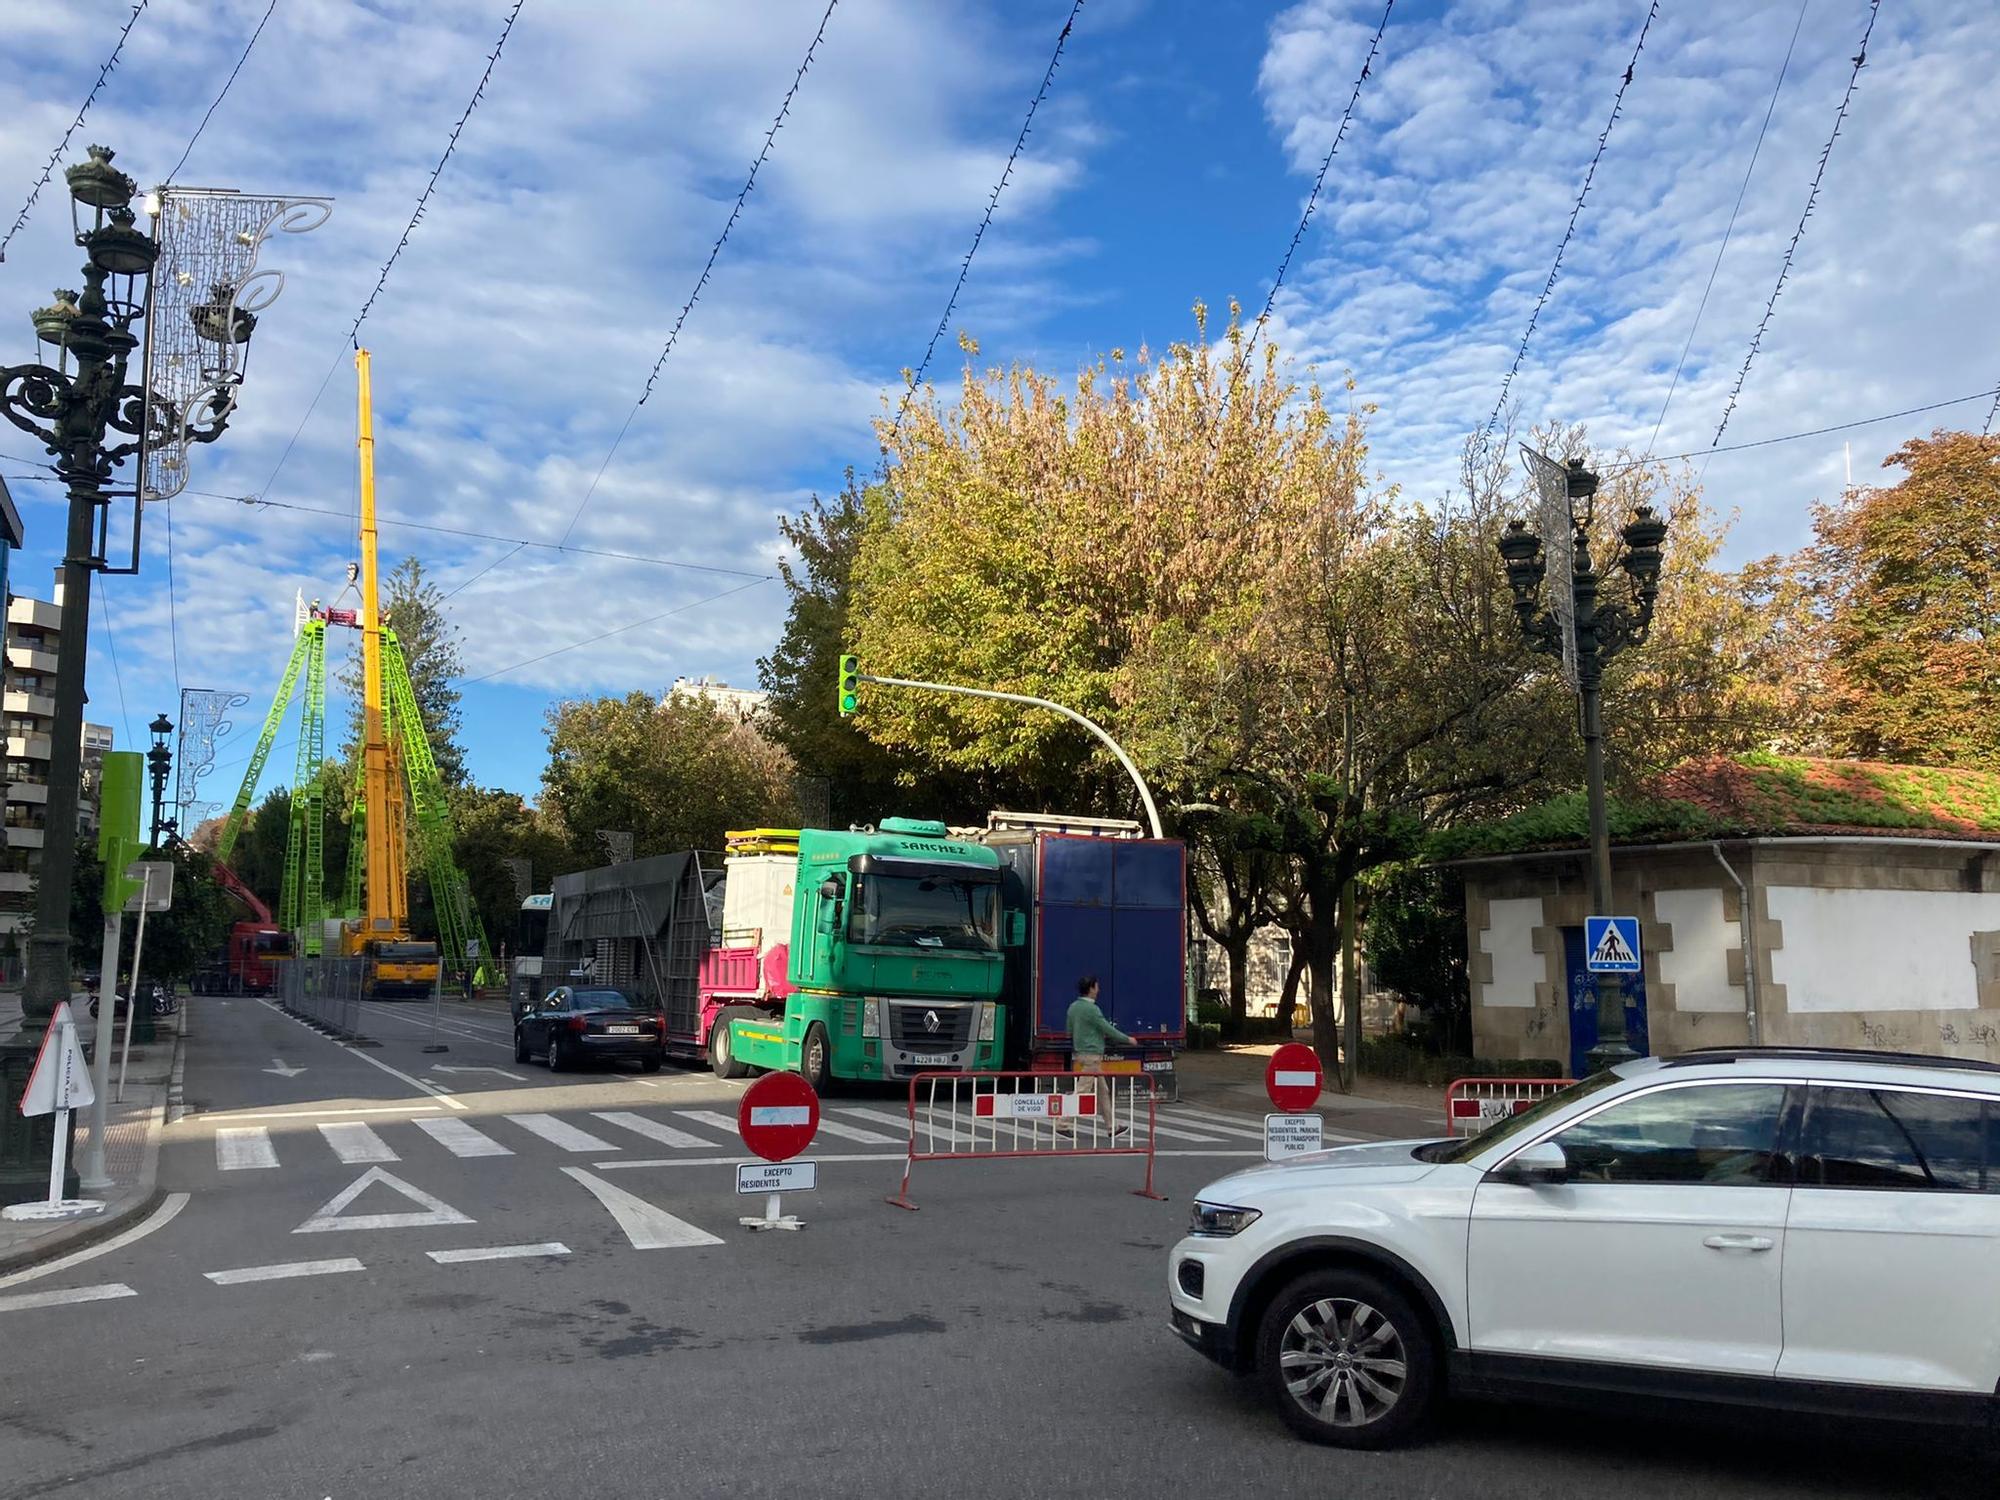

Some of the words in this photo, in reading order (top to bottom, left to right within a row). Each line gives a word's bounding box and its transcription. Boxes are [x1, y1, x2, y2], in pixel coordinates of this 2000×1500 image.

[900, 841, 967, 855] SANCHEZ
[65, 1049, 73, 1085] POLICIA
[1284, 1118, 1306, 1126] EXCEPTO
[763, 1167, 793, 1177] EXCEPTO
[740, 1178, 781, 1189] RESIDENTES
